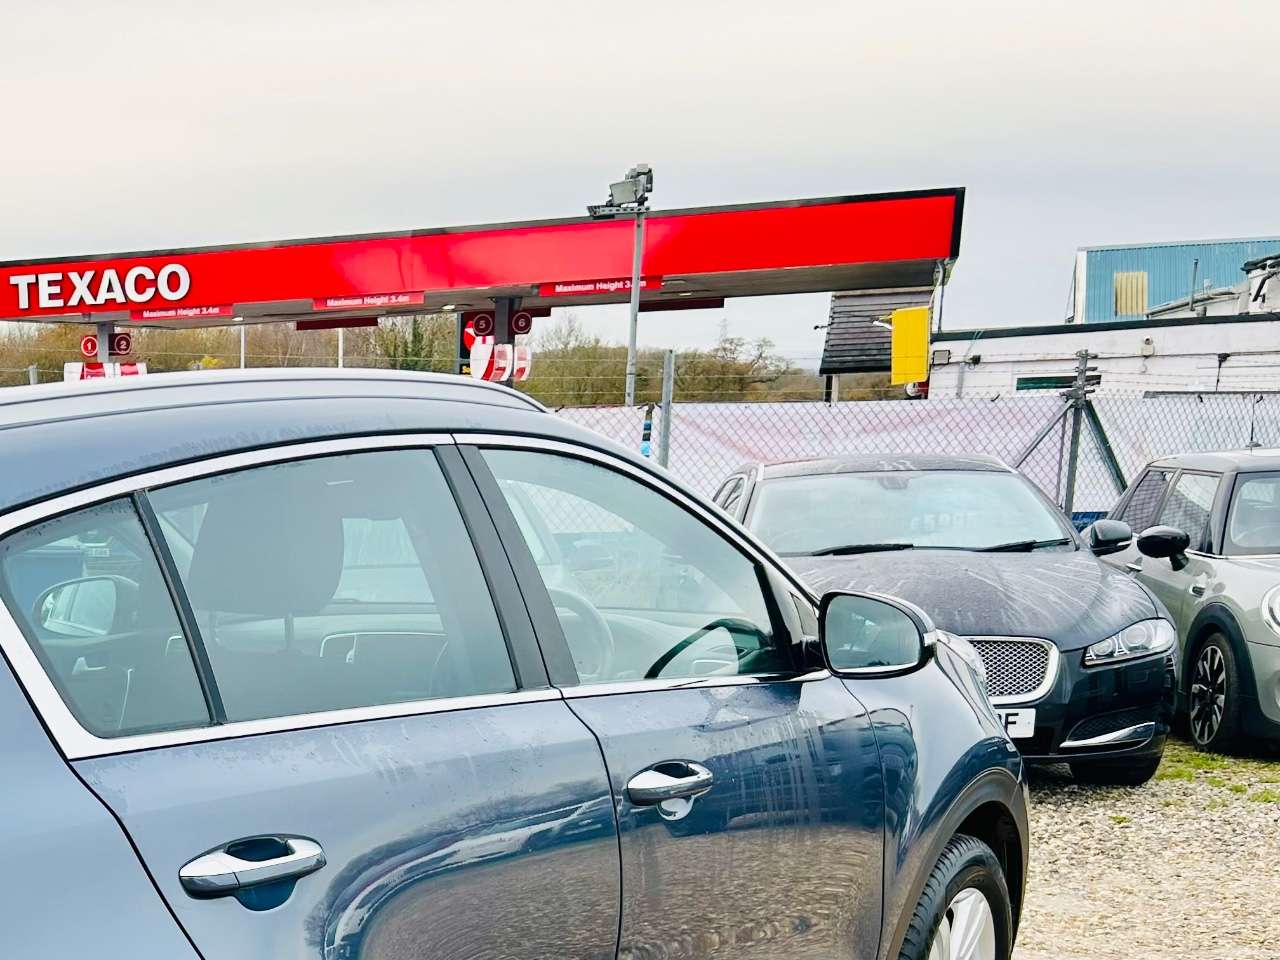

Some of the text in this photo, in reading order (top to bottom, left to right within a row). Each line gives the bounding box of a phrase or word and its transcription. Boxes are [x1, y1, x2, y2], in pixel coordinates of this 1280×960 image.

[9, 263, 191, 310] TEXACO
[554, 284, 595, 293] Maximum
[596, 281, 624, 291] Height
[326, 298, 363, 307] Maximum
[363, 295, 389, 305] Height
[142, 310, 177, 318] Maximum
[177, 308, 200, 316] Height
[479, 320, 486, 329] 5
[518, 318, 526, 327] 6
[120, 340, 128, 349] 2
